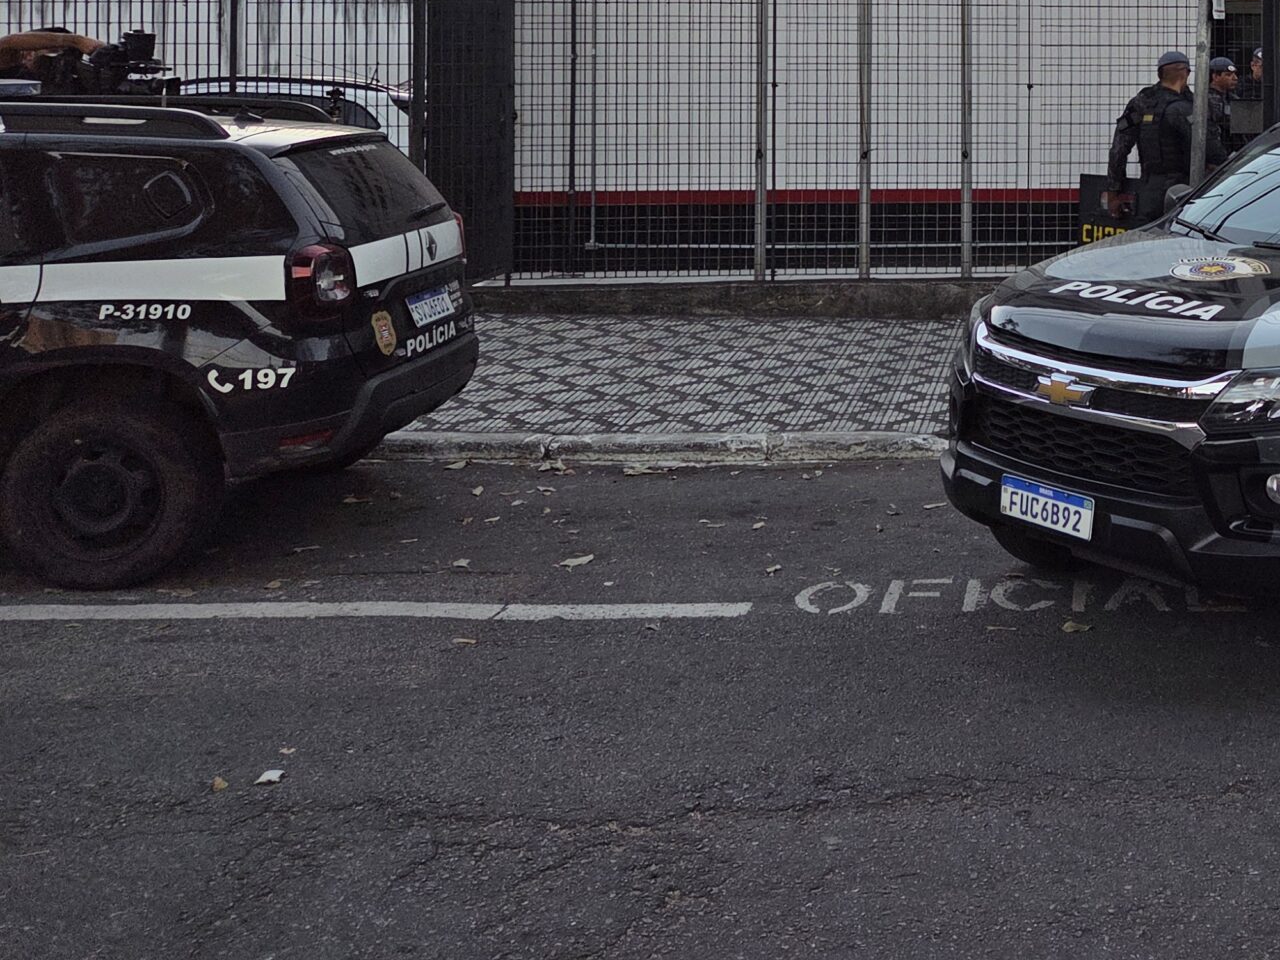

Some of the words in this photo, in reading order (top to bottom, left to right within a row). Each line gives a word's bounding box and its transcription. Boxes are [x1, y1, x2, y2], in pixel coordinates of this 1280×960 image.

[98, 304, 192, 320] P-31910
[1049, 281, 1225, 321] POLÍCIA
[406, 321, 457, 357] POLÍCIA
[238, 367, 296, 390] 197
[1009, 491, 1082, 533] FUC6B92
